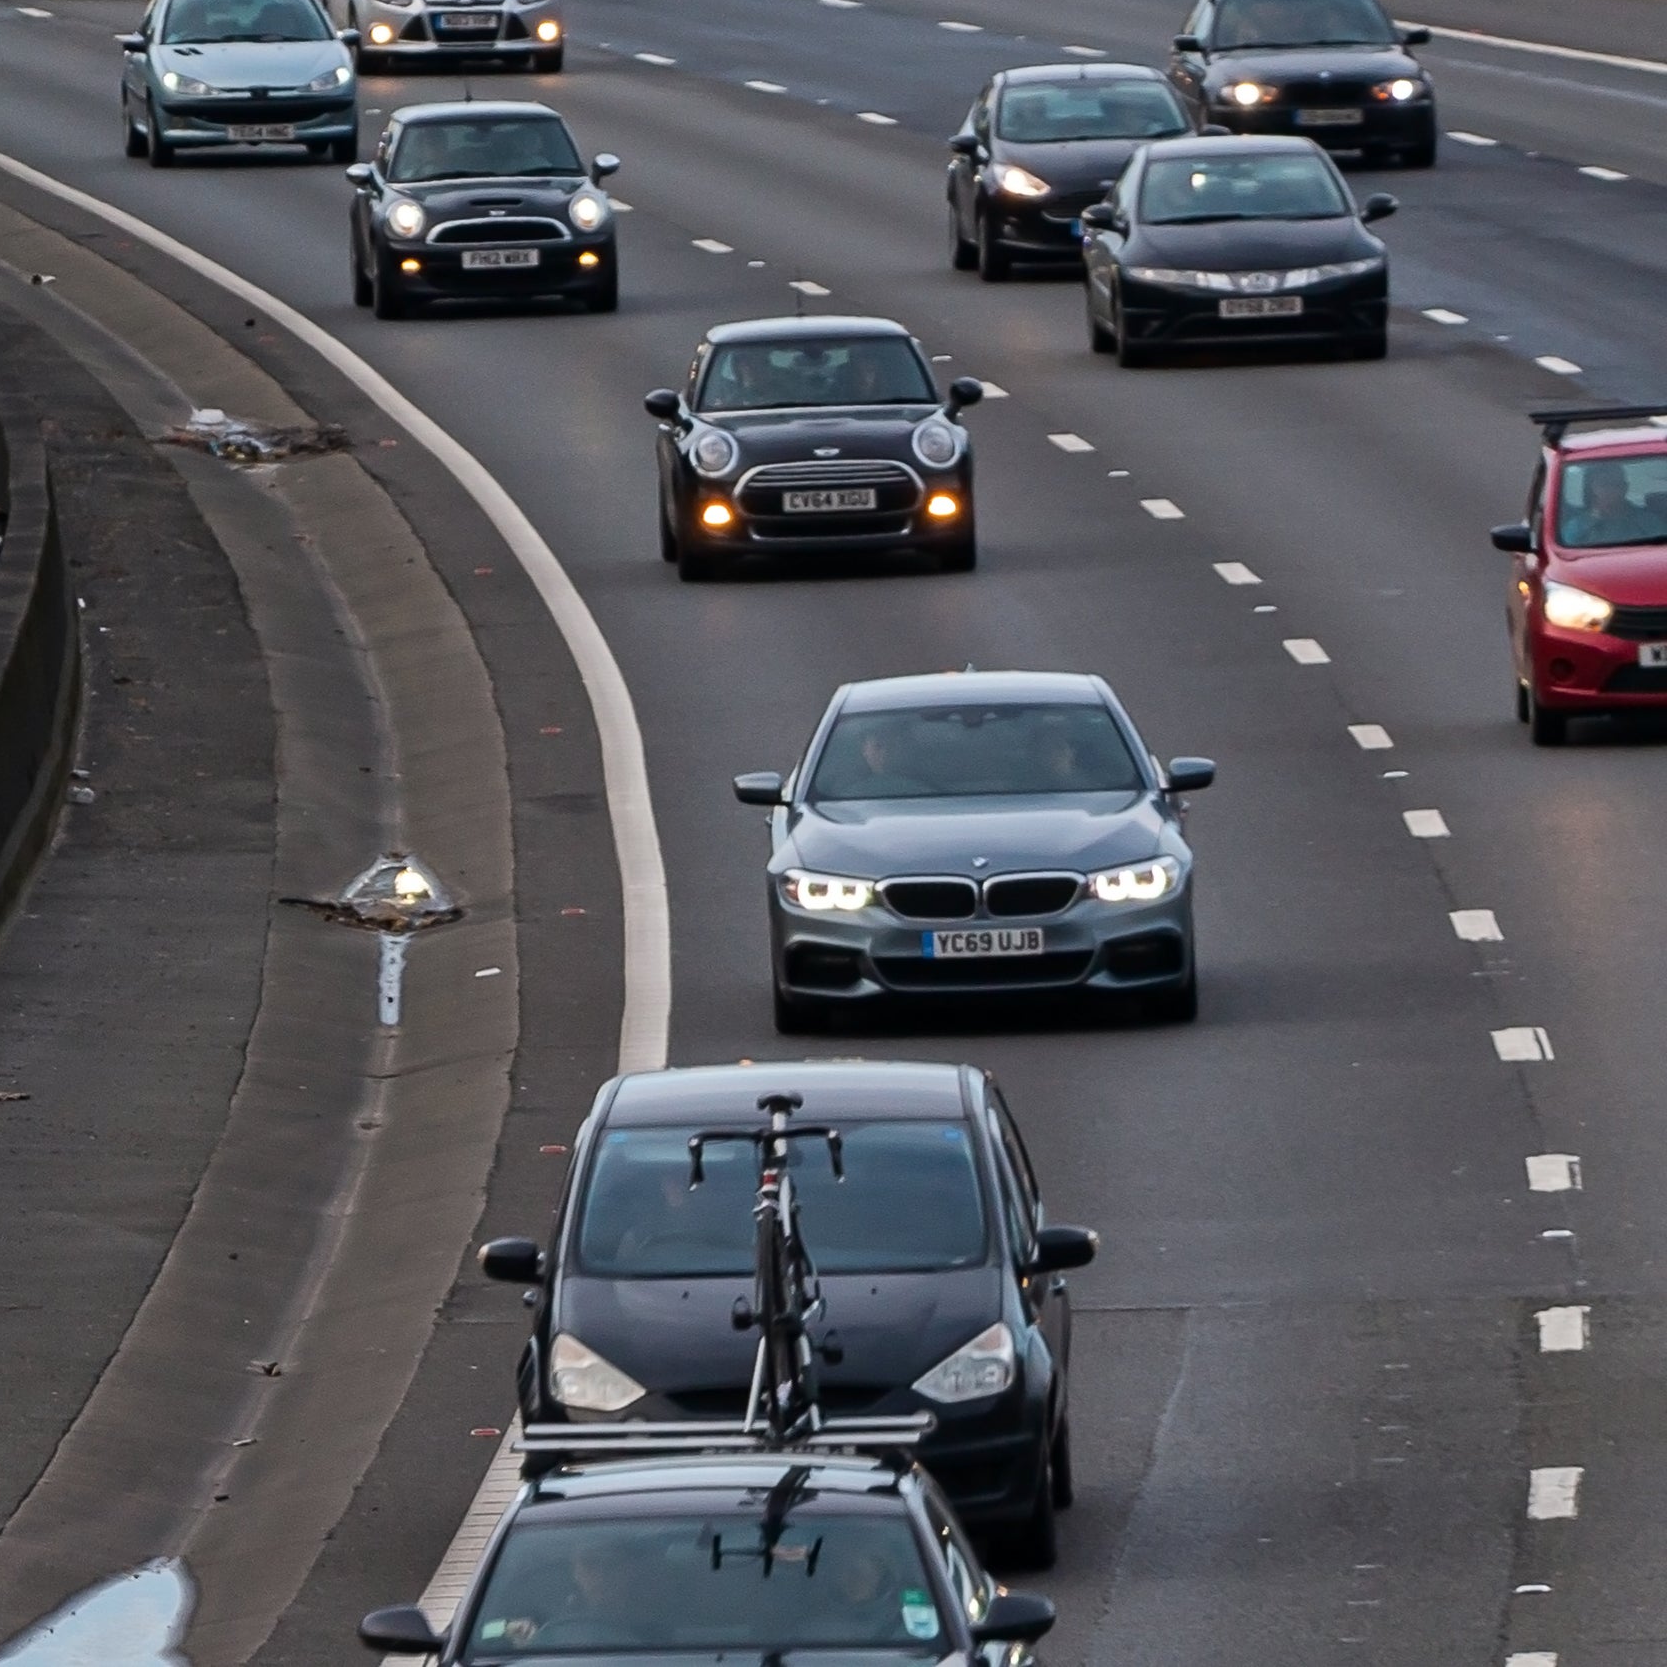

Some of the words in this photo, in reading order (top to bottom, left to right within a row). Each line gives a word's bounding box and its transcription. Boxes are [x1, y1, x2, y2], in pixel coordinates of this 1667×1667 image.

[789, 492, 833, 509] CV64
[936, 931, 992, 954] YC69
[996, 930, 1039, 951] UJB
